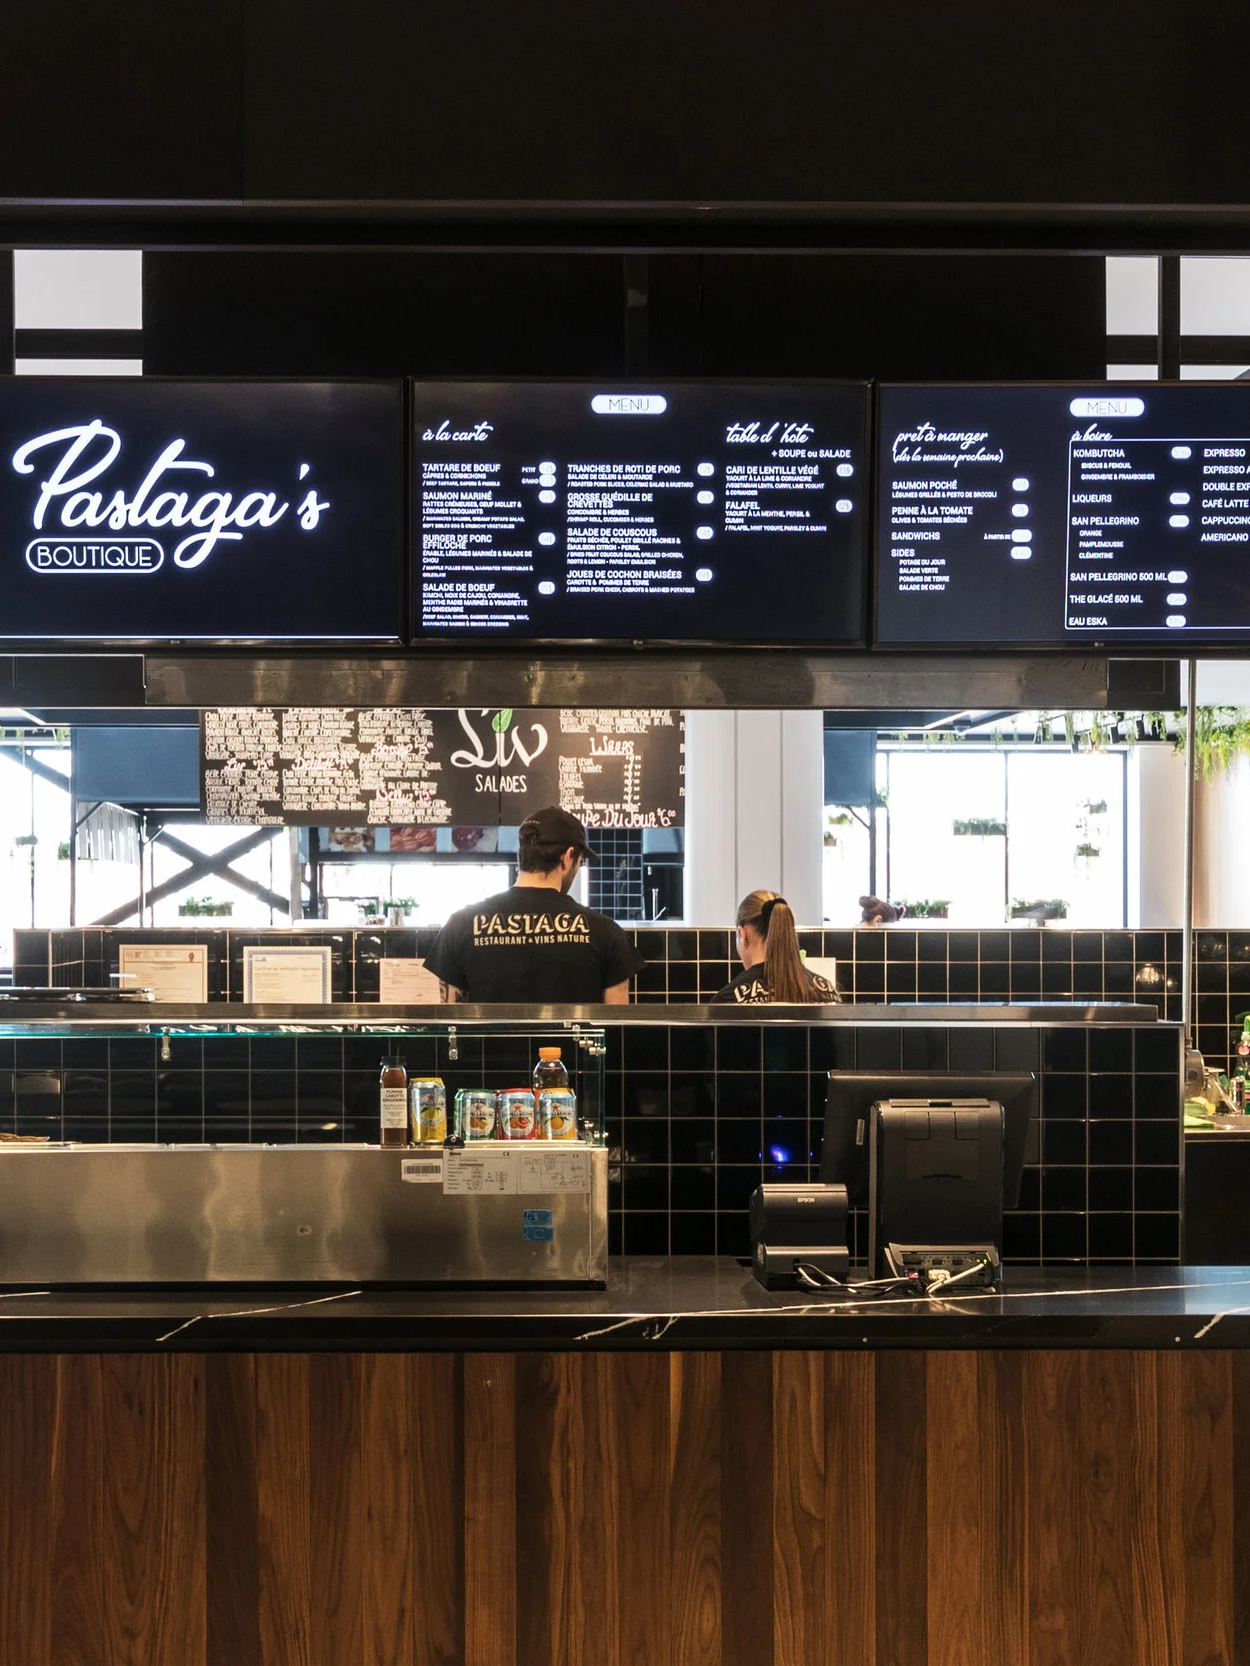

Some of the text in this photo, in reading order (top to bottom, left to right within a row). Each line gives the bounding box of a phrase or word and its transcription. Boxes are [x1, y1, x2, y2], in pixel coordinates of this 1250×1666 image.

[609, 398, 650, 412] MENU
[1087, 401, 1127, 414] MENU
[423, 420, 493, 441] à la carte
[726, 422, 760, 443] table
[1071, 423, 1112, 441] à boire
[893, 422, 988, 451] pret à manger
[1073, 449, 1125, 457] KOMBUTCHA
[1204, 449, 1246, 457] EXPRESSO
[423, 464, 500, 472] TARTARE DE BOEUF
[568, 465, 680, 473] TRANCHES DE ROTI DE PORC
[726, 465, 818, 474] CARI DE LENTILLE VÉGÉ
[1203, 466, 1245, 474] EXPRESSO
[930, 480, 957, 489] POCHÉ
[12, 419, 330, 569] Pastaga's
[423, 491, 492, 500] SAUMON MARINÉ
[568, 492, 652, 501] GROSSE GUÉDILLE DE
[1072, 495, 1112, 503] LIQUEURS
[1202, 498, 1249, 508] CAFÉ LATTE
[920, 505, 926, 514] À
[1072, 517, 1139, 525] SAN PELLEGRINO
[567, 528, 657, 536] SALADE DE COUSCOUS
[892, 532, 940, 540] SANDWICHS
[1201, 533, 1248, 541] AMERICANO
[37, 546, 152, 568] BOUTIQUE
[643, 569, 682, 578] BRAISÉES
[1070, 573, 1167, 581] SAN PELLEGRINO 500 ML
[1070, 594, 1143, 603] THE GLACÉ 500 ML
[1069, 617, 1107, 625] EAU ESKA
[451, 709, 548, 768] Liv
[475, 774, 527, 792] SALADES
[473, 913, 590, 936] PASTAGA
[474, 936, 526, 946] RESTAURANT
[534, 935, 555, 944] VINS
[557, 935, 590, 944] NATURE
